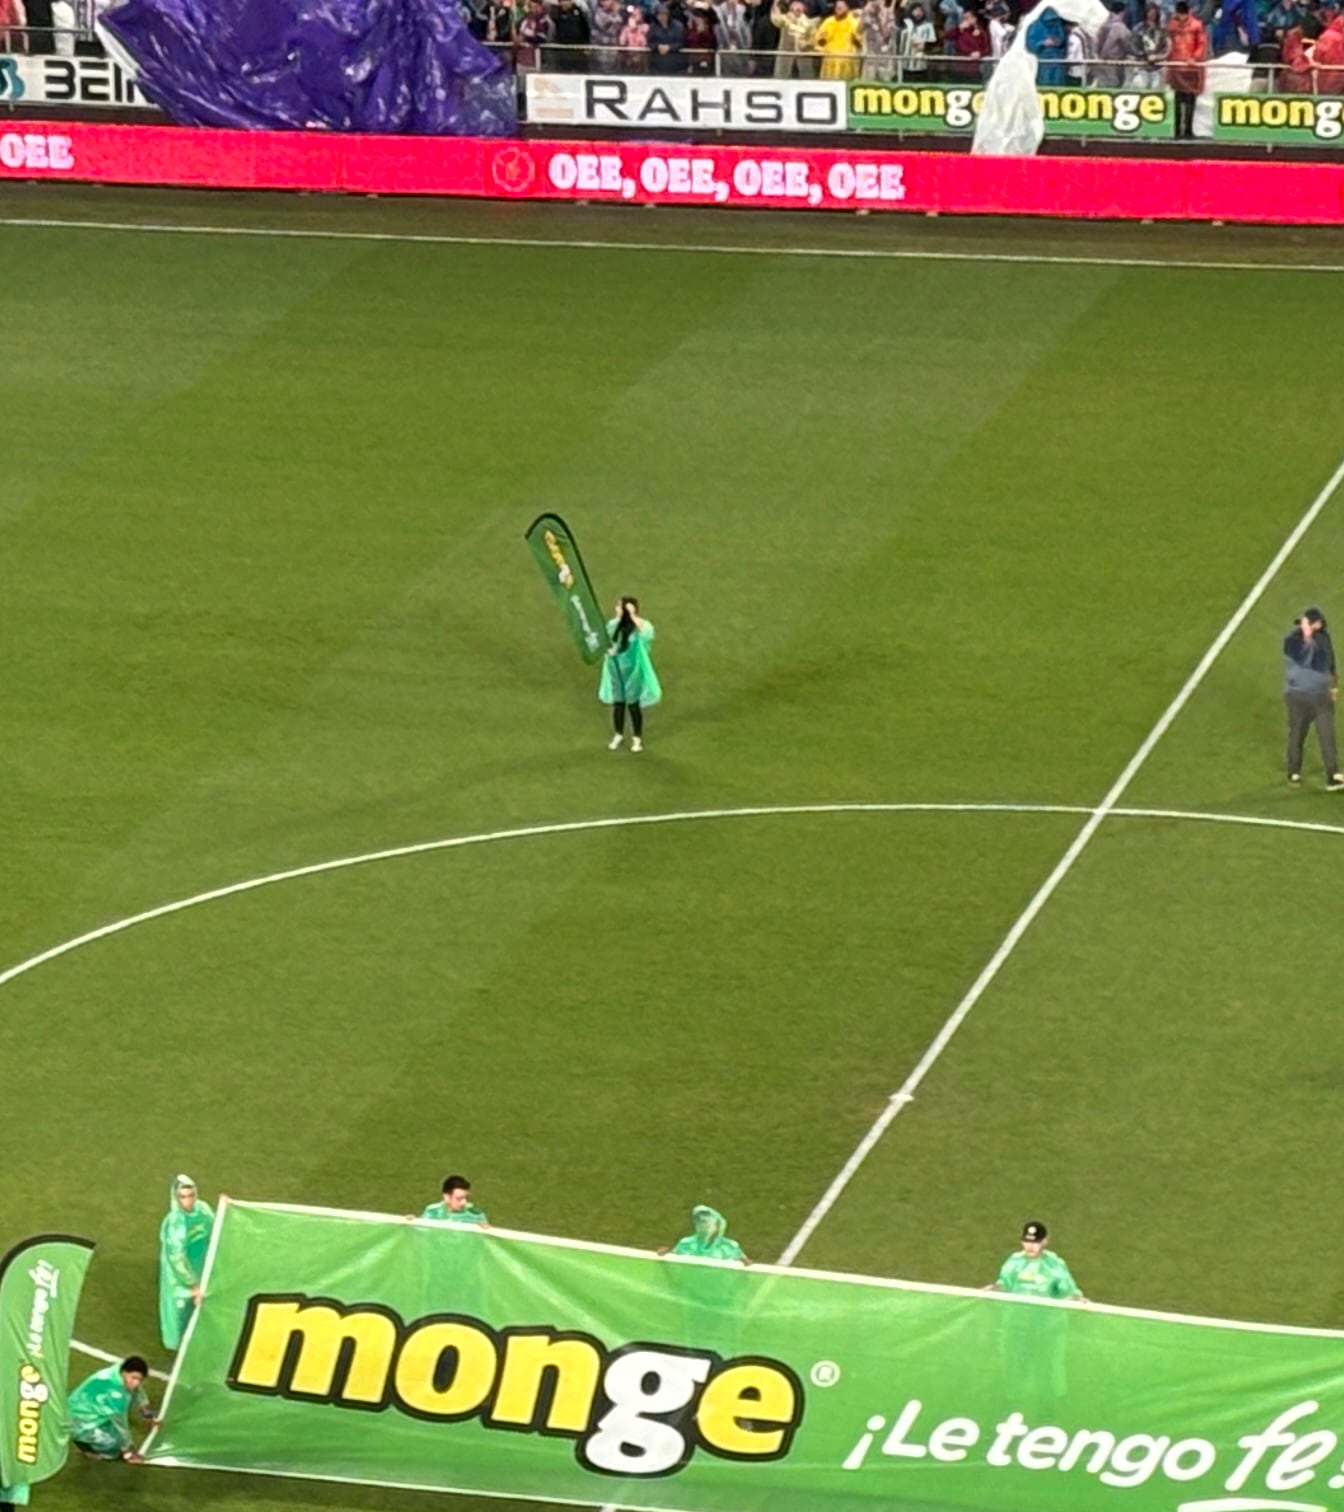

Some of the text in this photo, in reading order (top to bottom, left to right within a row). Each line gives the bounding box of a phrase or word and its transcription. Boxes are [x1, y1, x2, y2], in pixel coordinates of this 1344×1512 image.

[584, 79, 838, 126] RAHSO
[549, 152, 905, 204] OEE, OEE, OEE, OEE
[17, 1365, 49, 1465] monge
[231, 1296, 802, 1476] monge
[842, 1398, 980, 1470] ¡Le
[985, 1412, 1216, 1488] tengo
